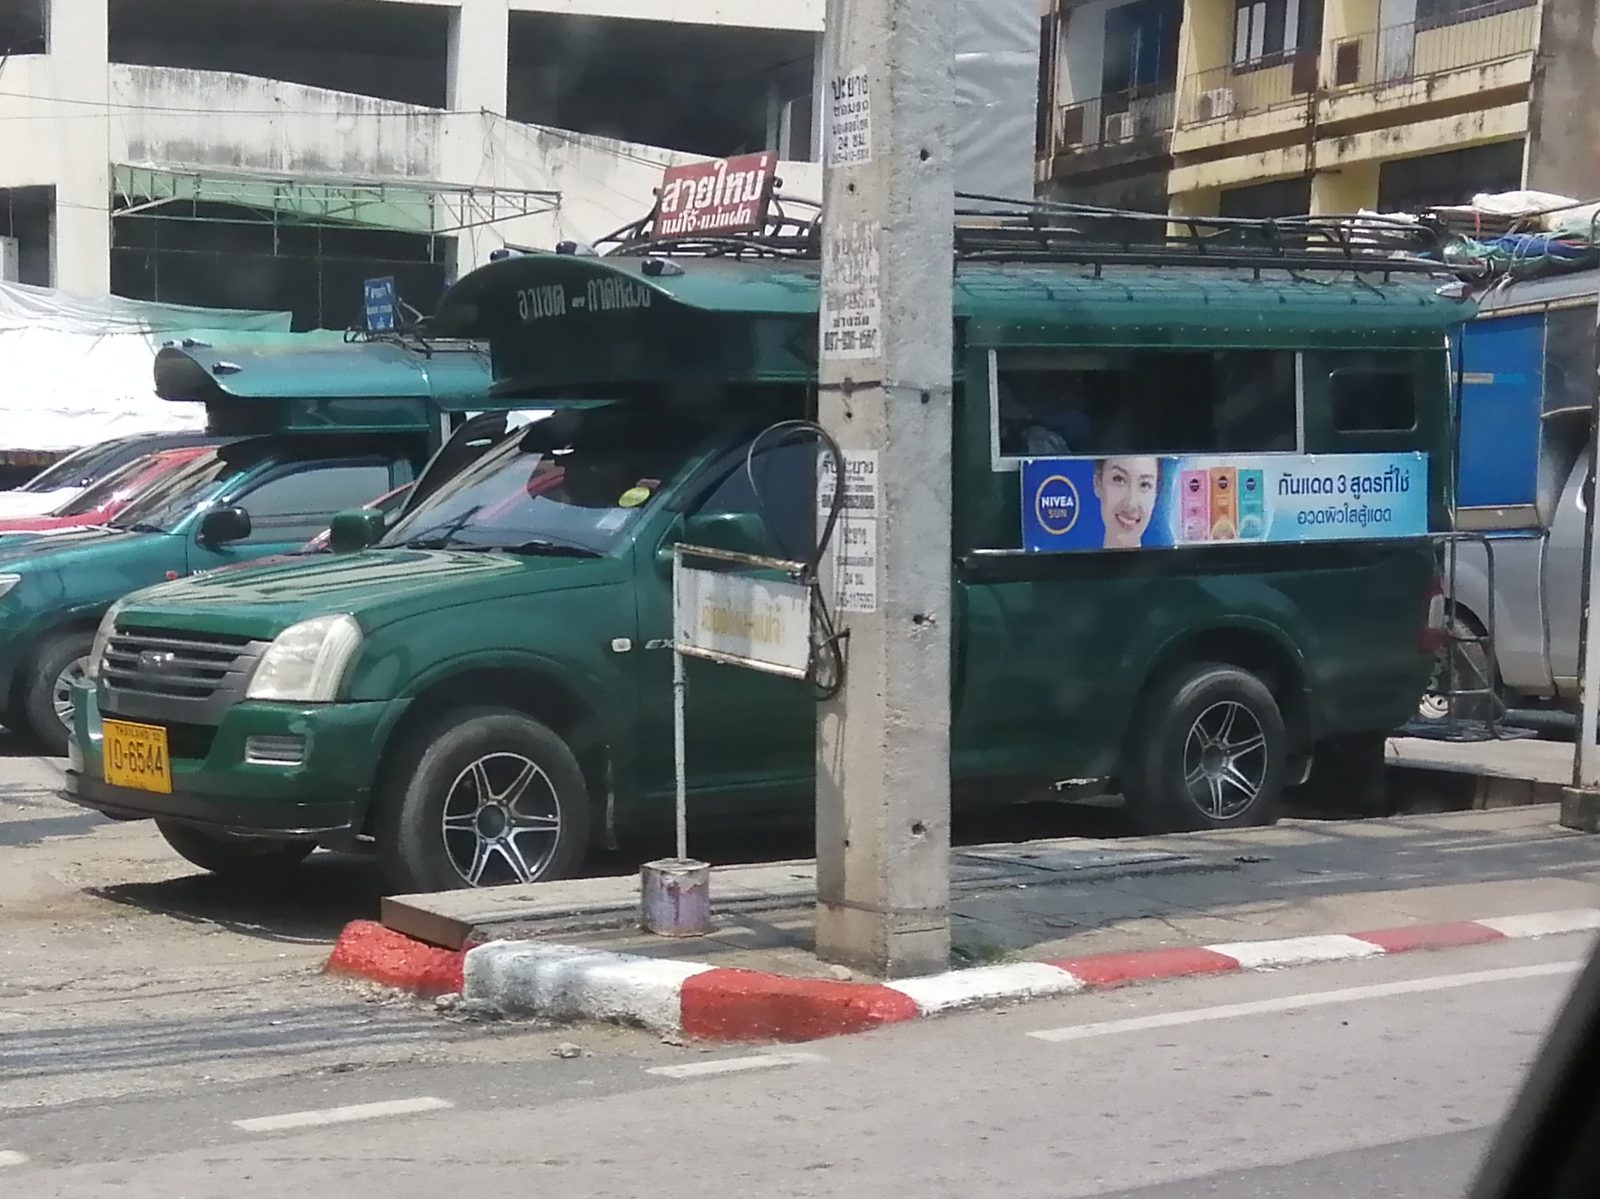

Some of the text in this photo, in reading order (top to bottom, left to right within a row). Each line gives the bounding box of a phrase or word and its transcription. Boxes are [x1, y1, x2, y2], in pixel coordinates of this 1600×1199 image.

[661, 156, 768, 213] สายใหม่
[1278, 464, 1410, 500] กันแดด 3 สูตรที่ใช่
[1041, 496, 1074, 508] NIVEA
[1048, 509, 1067, 519] SUN
[1297, 502, 1392, 528] อวดผิวใสสู้แดด
[108, 738, 164, 777] 10-6544
